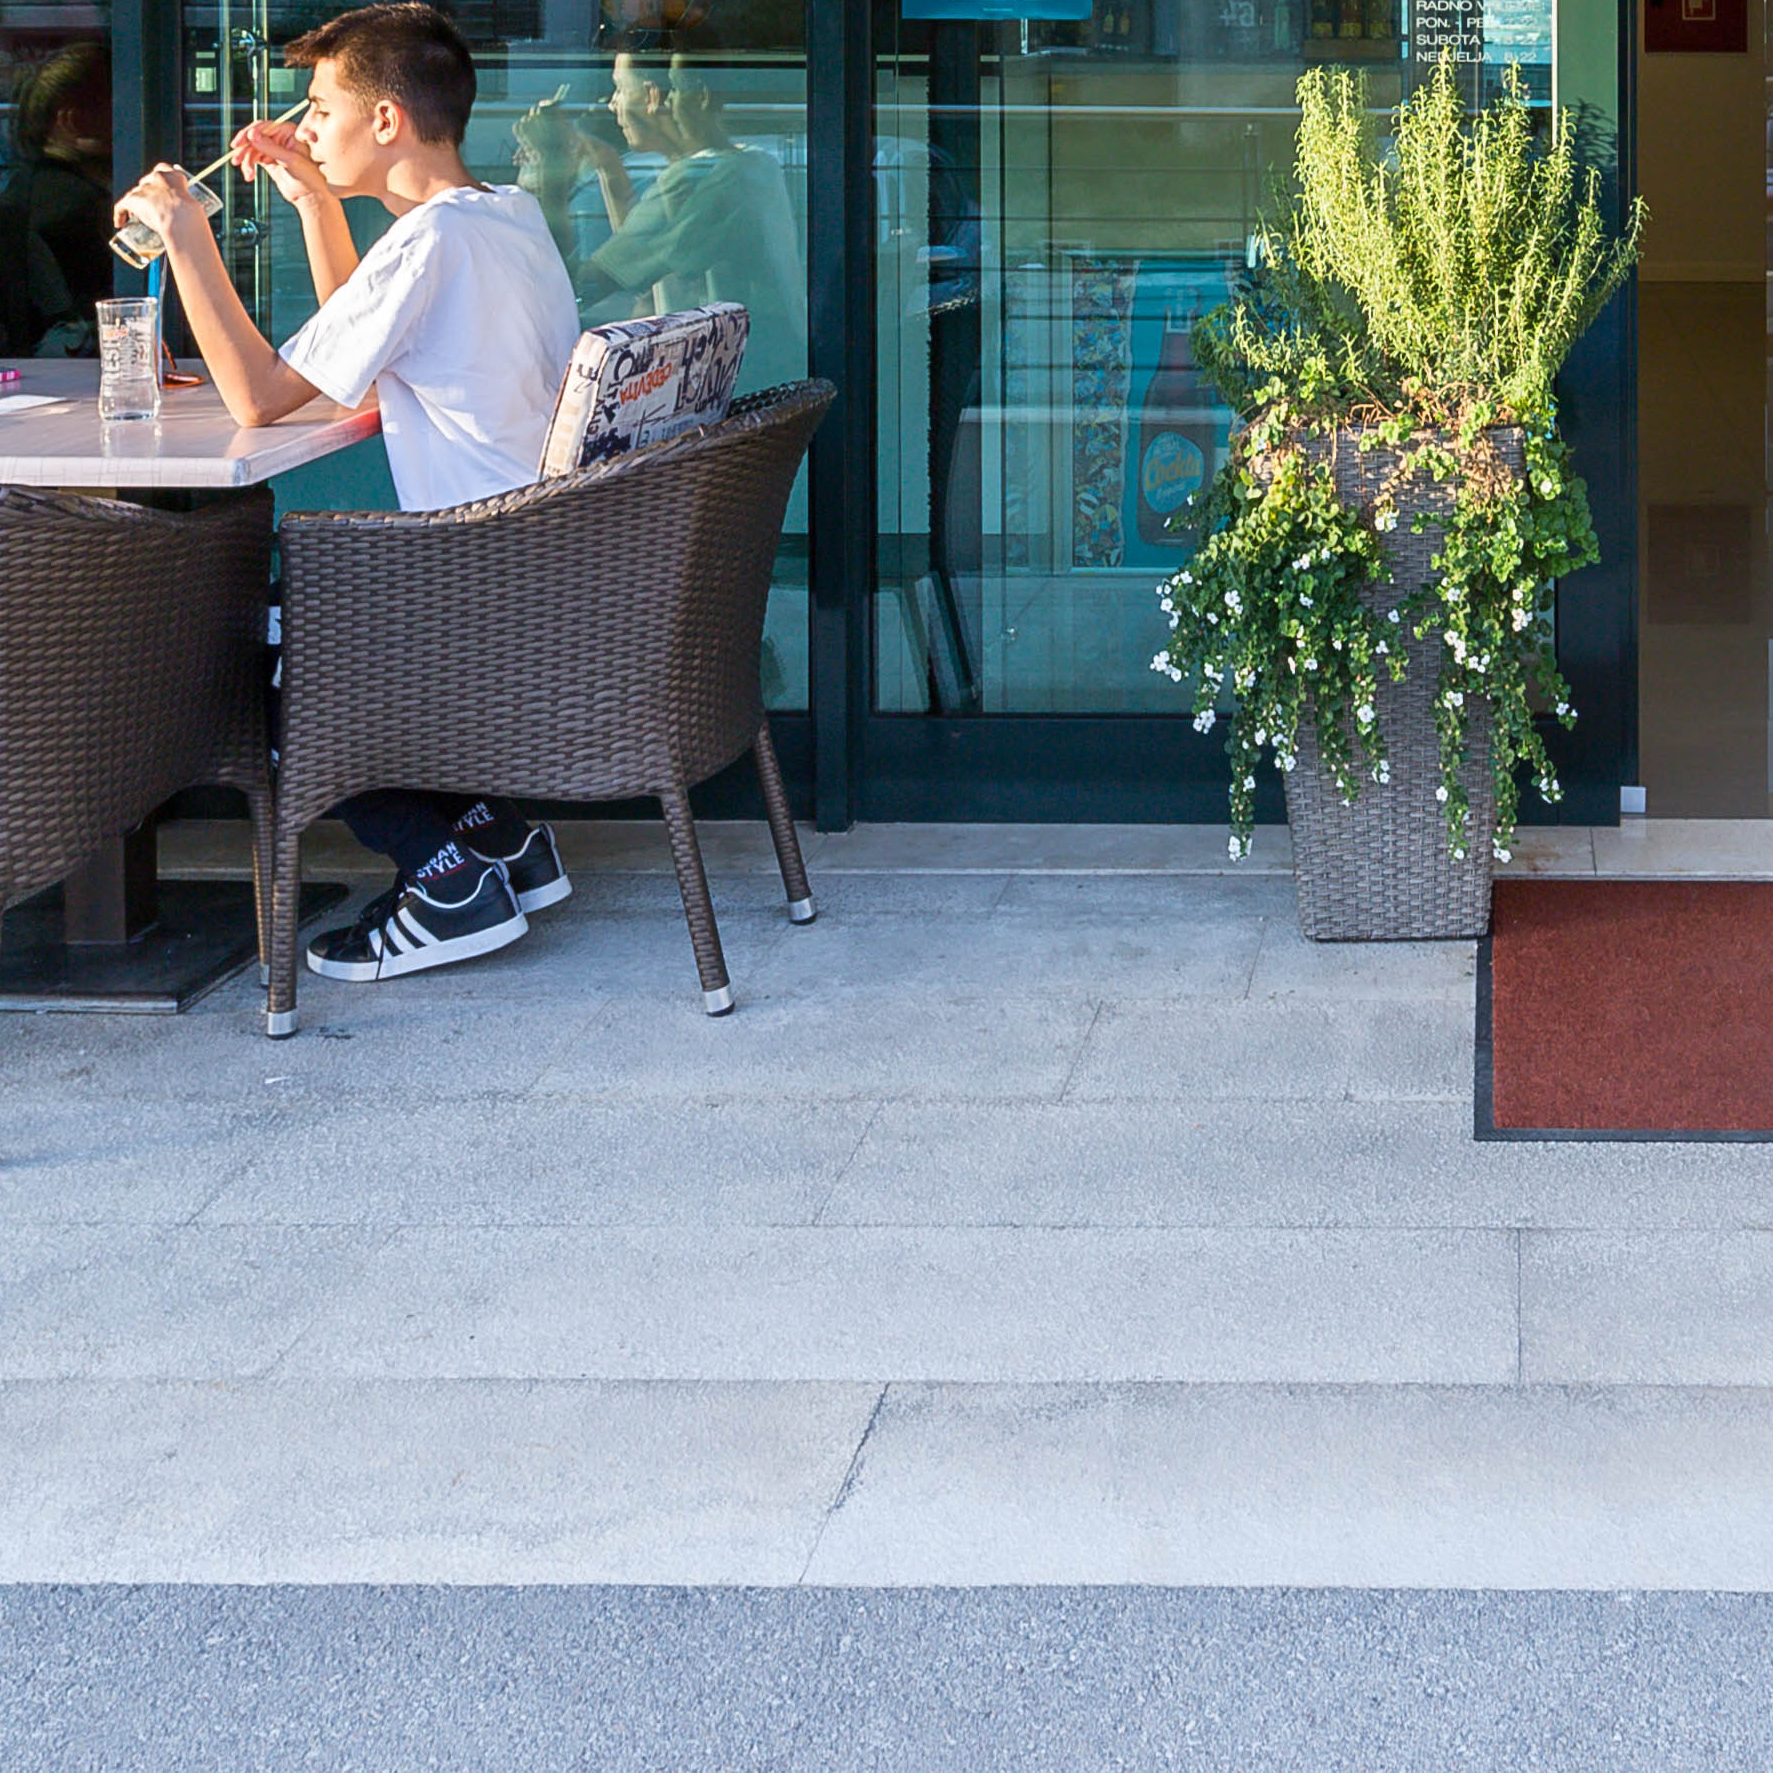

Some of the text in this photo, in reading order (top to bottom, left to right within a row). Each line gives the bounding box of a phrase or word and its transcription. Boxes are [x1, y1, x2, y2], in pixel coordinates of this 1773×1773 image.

[1416, 0, 1472, 11] RADNO
[1416, 17, 1451, 28] PON.
[1416, 34, 1481, 45] SUBOTA
[619, 362, 673, 405] CEDEVITA
